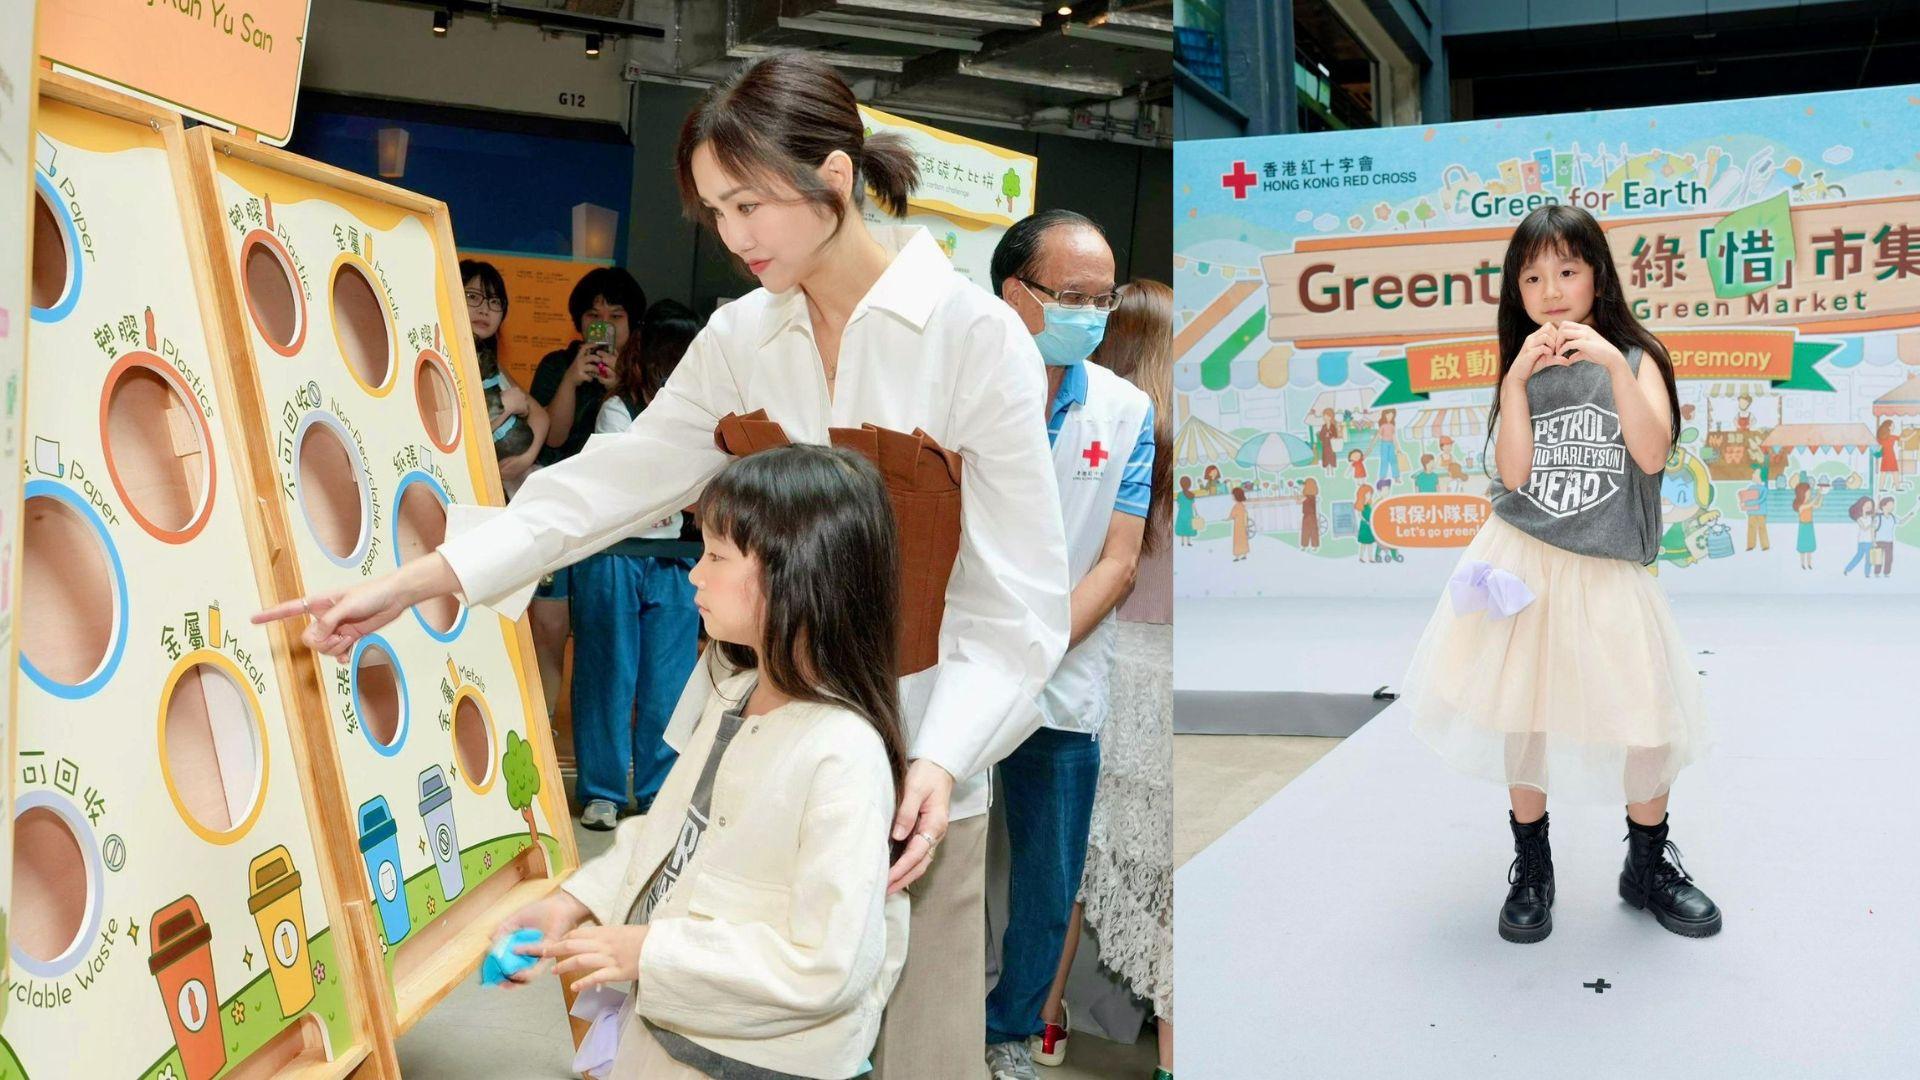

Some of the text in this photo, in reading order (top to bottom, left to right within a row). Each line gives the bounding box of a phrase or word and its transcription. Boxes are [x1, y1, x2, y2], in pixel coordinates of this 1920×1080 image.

[163, 0, 273, 53] an Yu San
[559, 92, 586, 108] G12
[1263, 155, 1373, 178] 香港紅十字會
[1263, 171, 1417, 192] HONG KONG RED CROSS
[59, 176, 96, 262] Paper
[228, 197, 263, 236] 塑膠
[1471, 180, 1707, 218] Green for Earth
[277, 223, 312, 302] Plastics
[1631, 224, 1920, 290] 綠「惜」市集
[374, 260, 400, 320] Metals
[1299, 259, 1501, 313] Greent
[1632, 291, 1868, 320] Green Market
[93, 315, 140, 359] 塑膠
[162, 338, 214, 418] Plastics
[1430, 349, 1498, 381] 啟動
[1534, 408, 1607, 444] PETROL
[70, 459, 119, 526] Paper
[435, 464, 458, 504] Pape
[1528, 470, 1601, 511] HEAD
[1396, 525, 1426, 537] Let's
[1428, 528, 1441, 538] go
[361, 536, 382, 577] Waste
[161, 611, 205, 660] 金屬
[223, 628, 266, 694] Metals
[458, 665, 486, 694] Metals
[75, 918, 119, 991] Waste
